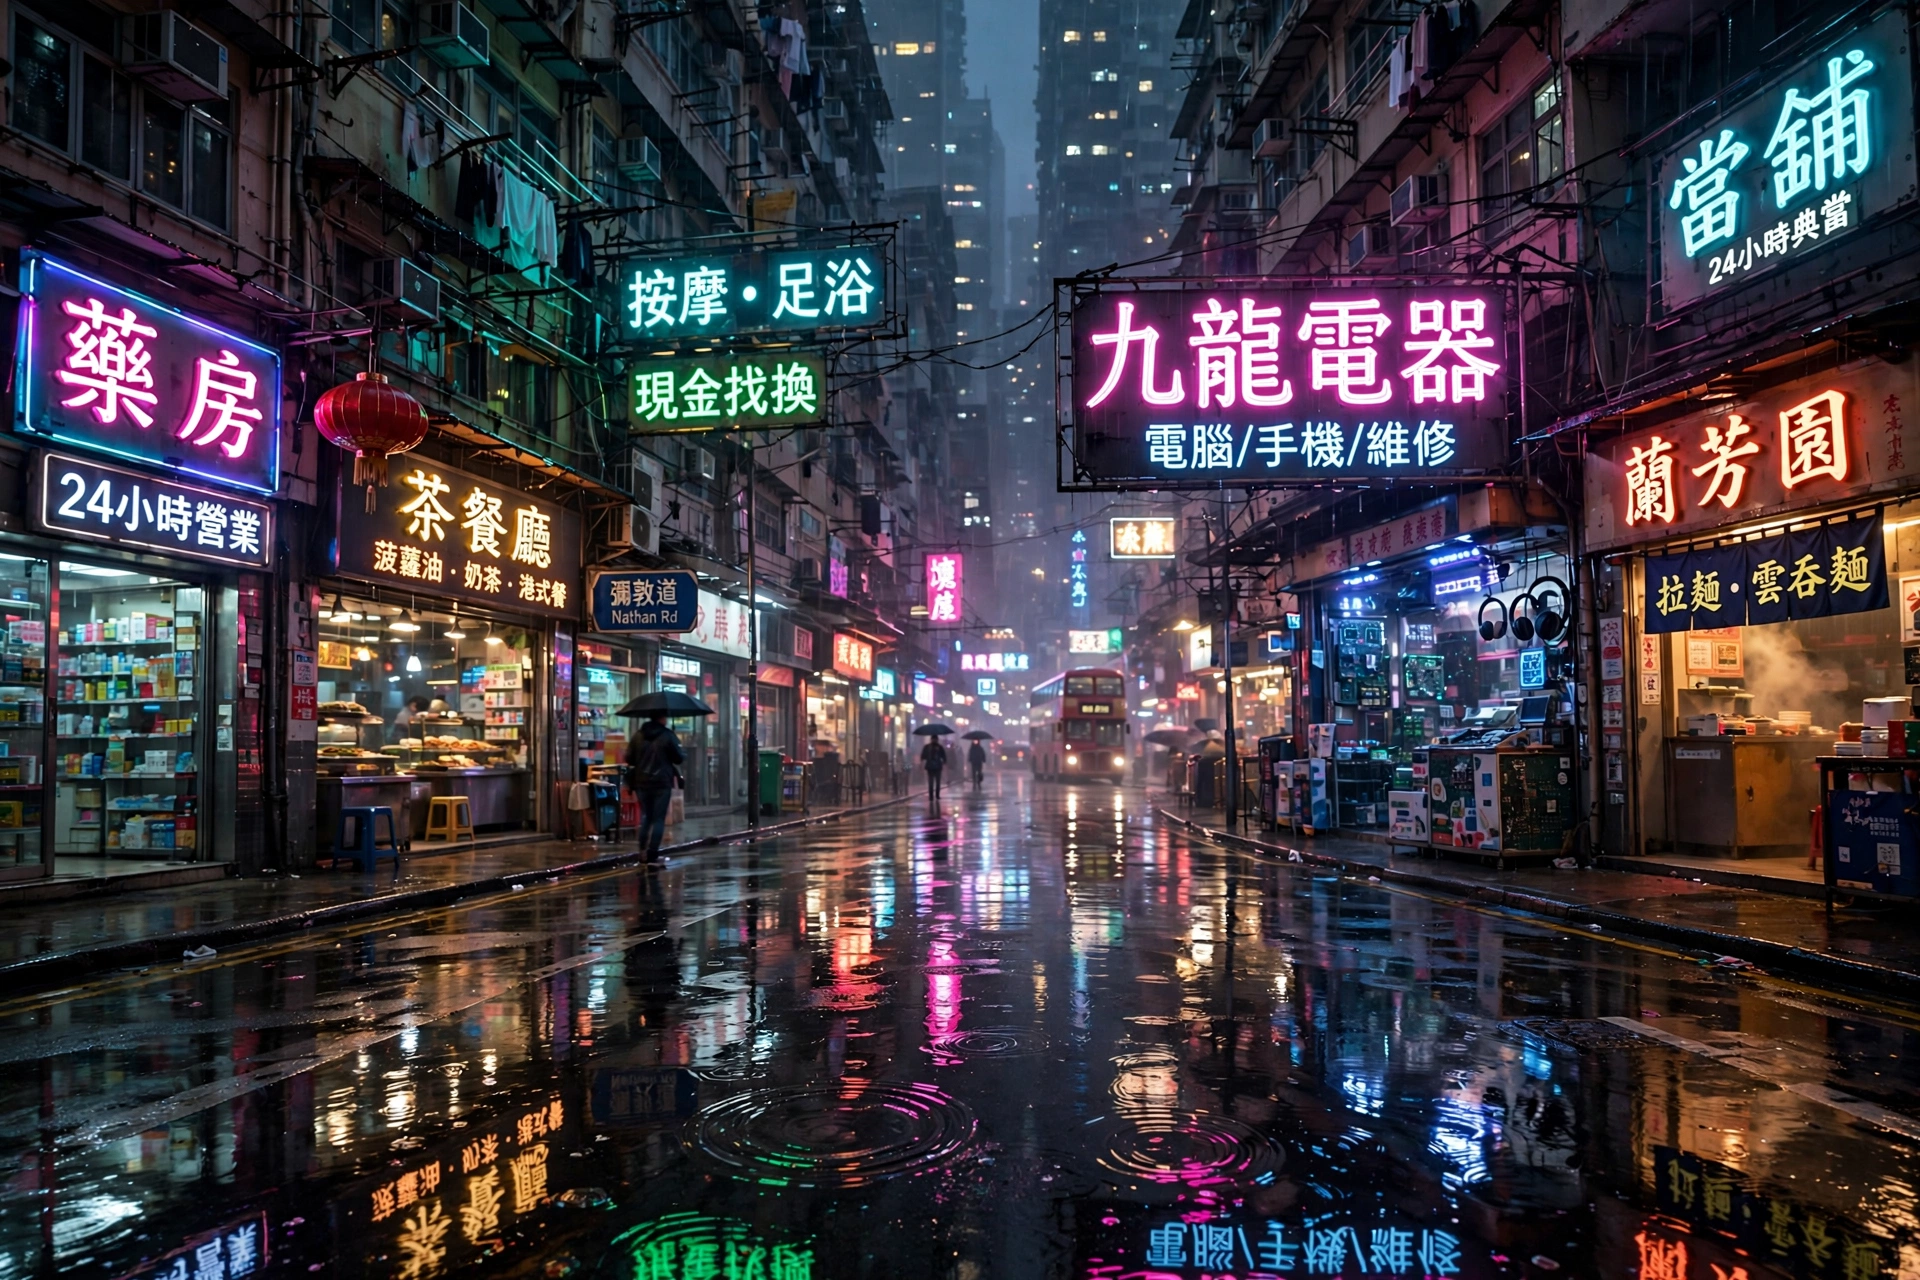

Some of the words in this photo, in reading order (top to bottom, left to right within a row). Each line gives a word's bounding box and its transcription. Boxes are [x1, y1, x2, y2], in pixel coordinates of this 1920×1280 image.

[1708, 189, 1851, 285] 24小時典當
[56, 298, 263, 458] 藥房
[634, 361, 817, 422] 現金找換
[1086, 297, 1501, 408] 九龍電器
[1144, 419, 1456, 470] 電腦/手機/維修
[1625, 389, 1848, 526] 蘭芳園
[58, 472, 261, 554] 24小時營業
[399, 469, 552, 568] 茶餐廳
[610, 578, 678, 607] 彌敦道
[611, 610, 657, 624] Nathan
[661, 610, 678, 623] Rd
